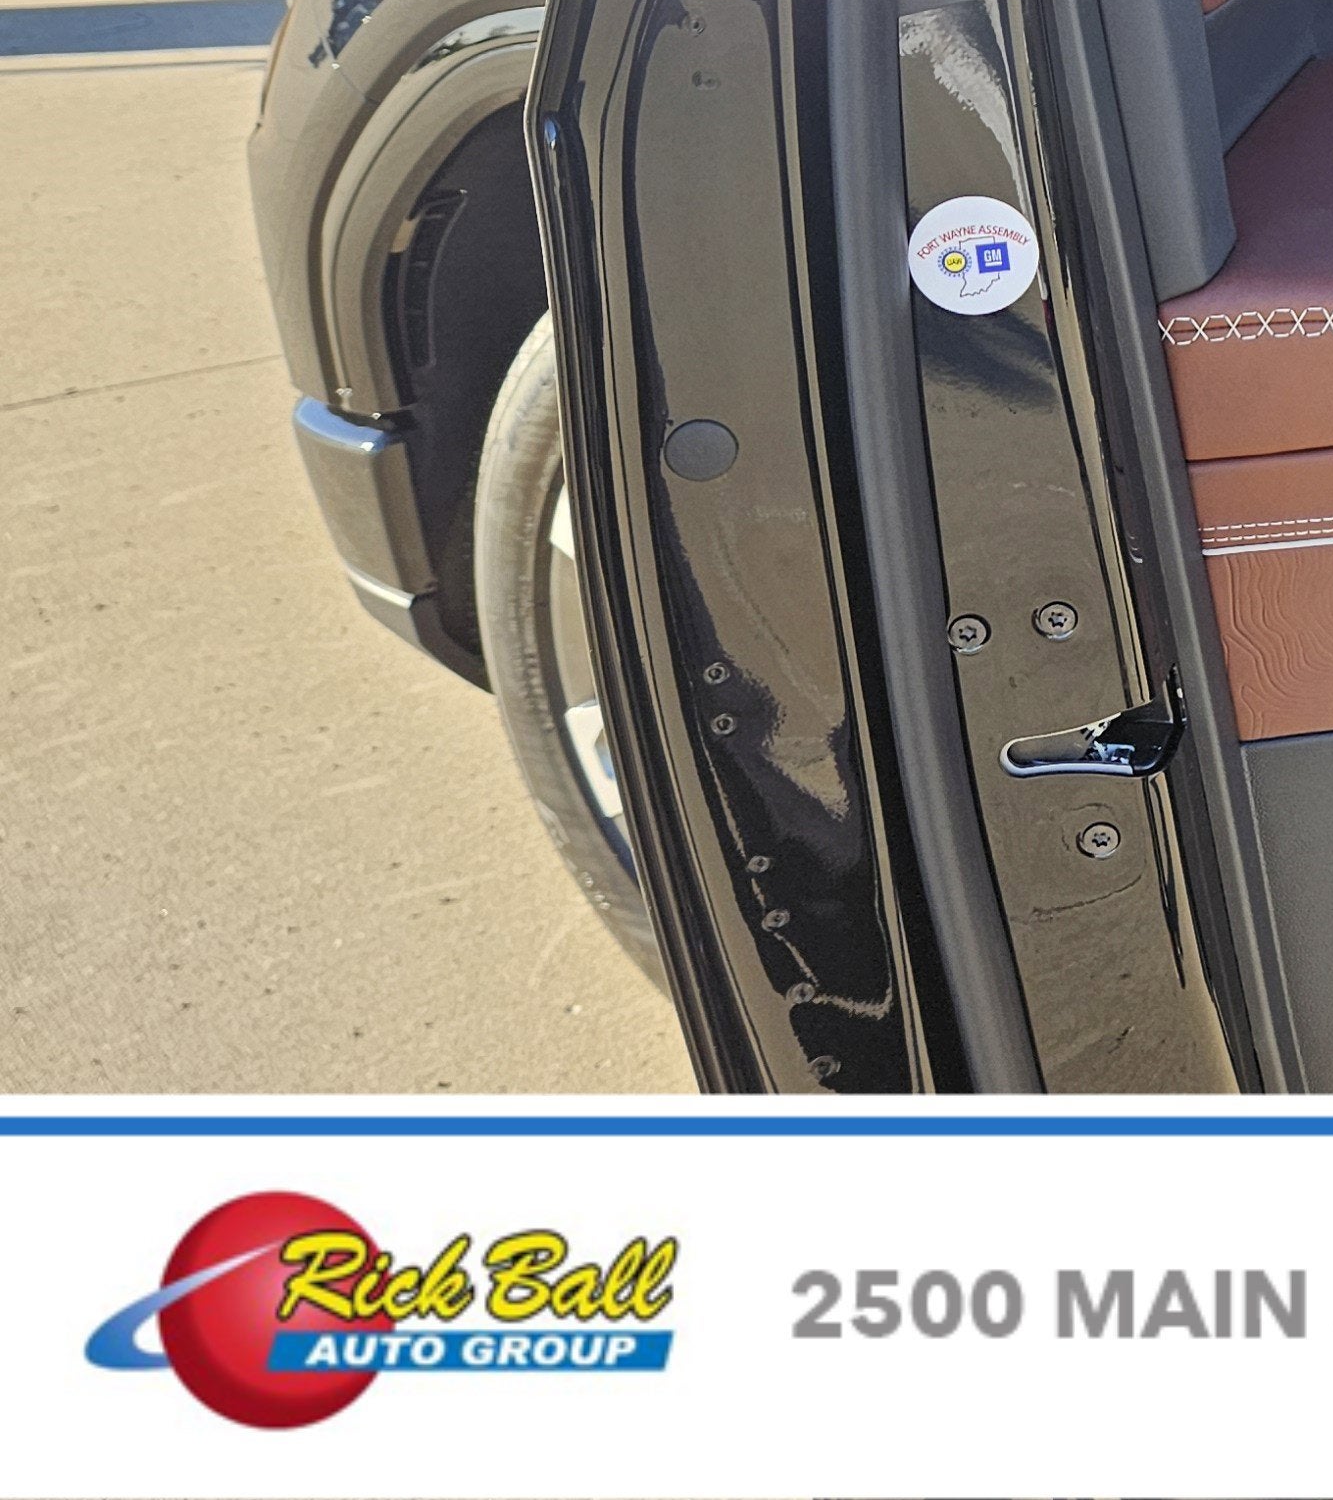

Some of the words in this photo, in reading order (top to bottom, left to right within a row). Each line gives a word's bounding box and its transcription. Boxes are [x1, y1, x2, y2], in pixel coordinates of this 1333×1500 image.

[917, 239, 940, 260] FORT
[940, 224, 976, 243] WAYNE
[978, 224, 1030, 246] ASSEMBLY
[983, 248, 1003, 264] GM
